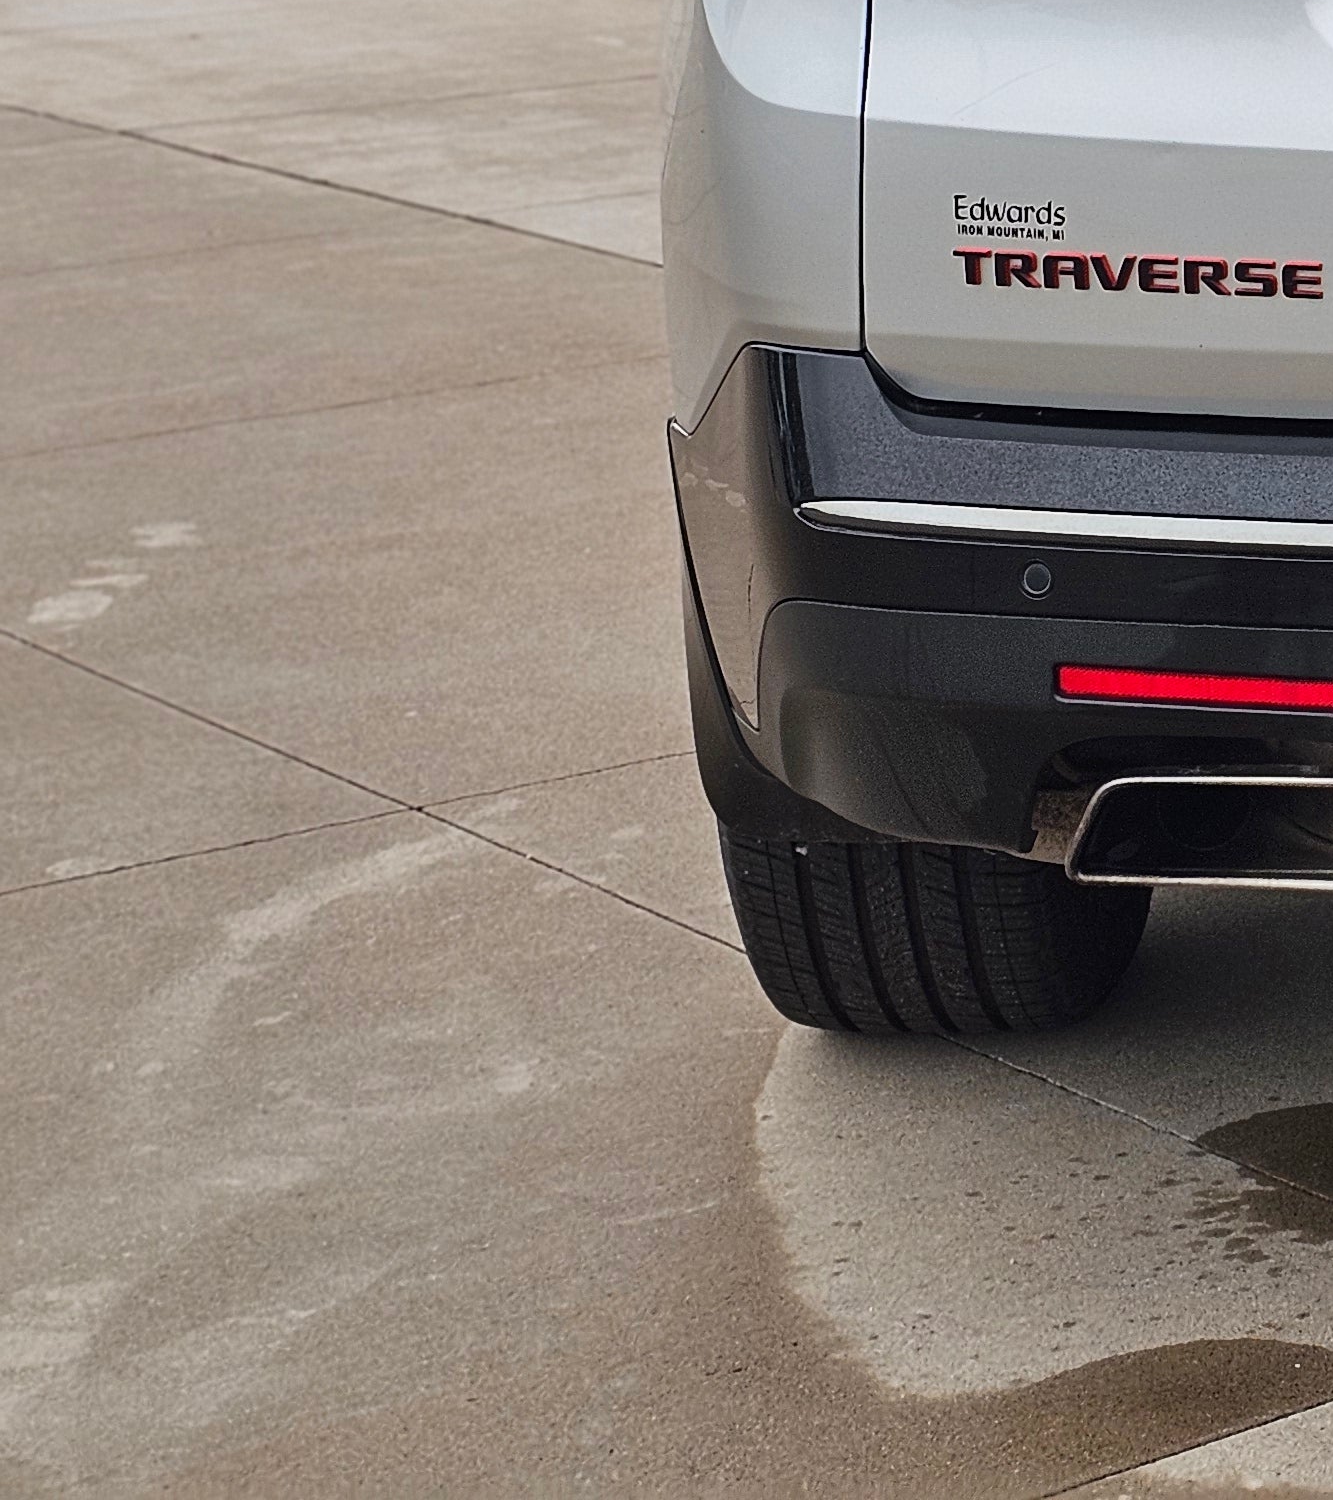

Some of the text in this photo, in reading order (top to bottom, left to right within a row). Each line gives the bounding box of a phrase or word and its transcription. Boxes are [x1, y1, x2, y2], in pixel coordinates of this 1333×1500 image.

[953, 195, 1066, 226] Edwards
[957, 224, 1065, 240] IRON MOUNTAIN, MI
[953, 246, 1324, 299] TRAVERSE
